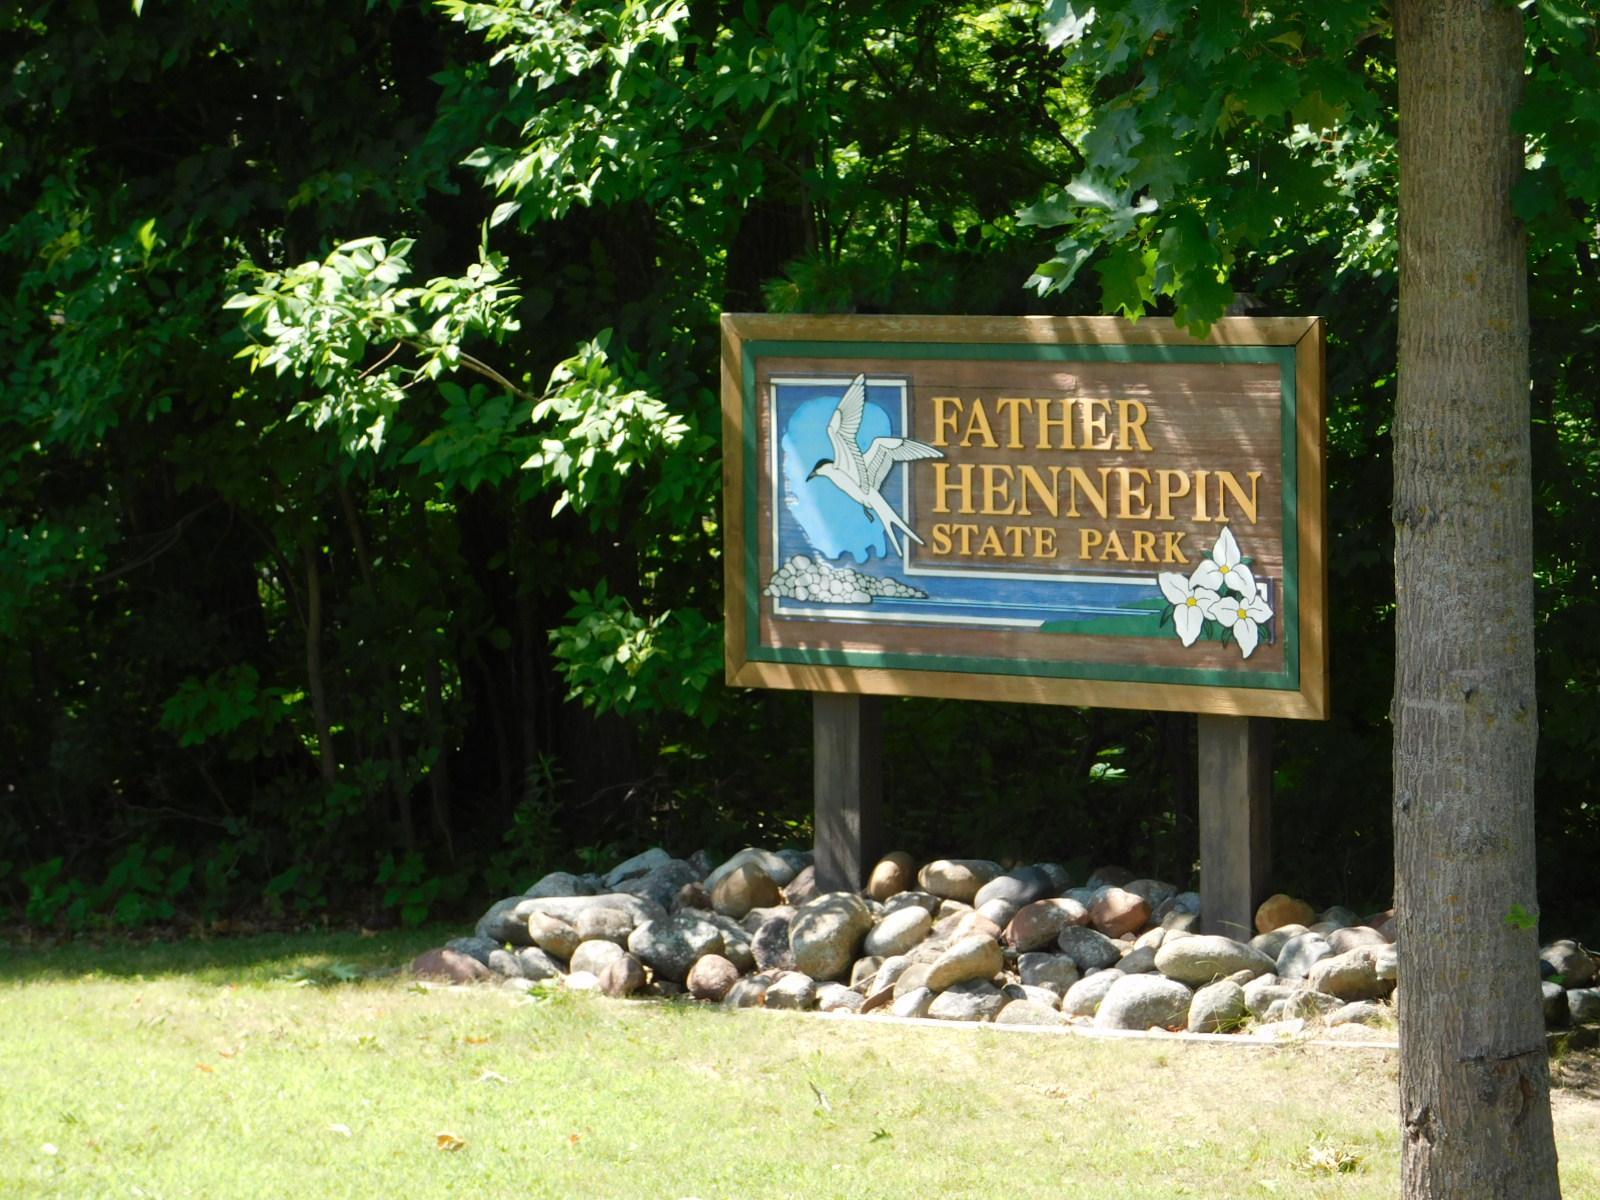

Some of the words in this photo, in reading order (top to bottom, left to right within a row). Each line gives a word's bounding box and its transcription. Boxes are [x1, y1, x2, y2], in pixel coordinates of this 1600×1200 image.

[932, 396, 1153, 451] FATHER
[932, 462, 1262, 525] HENNEPIN
[932, 523, 1057, 559] STATE
[1079, 528, 1189, 564] PARK
